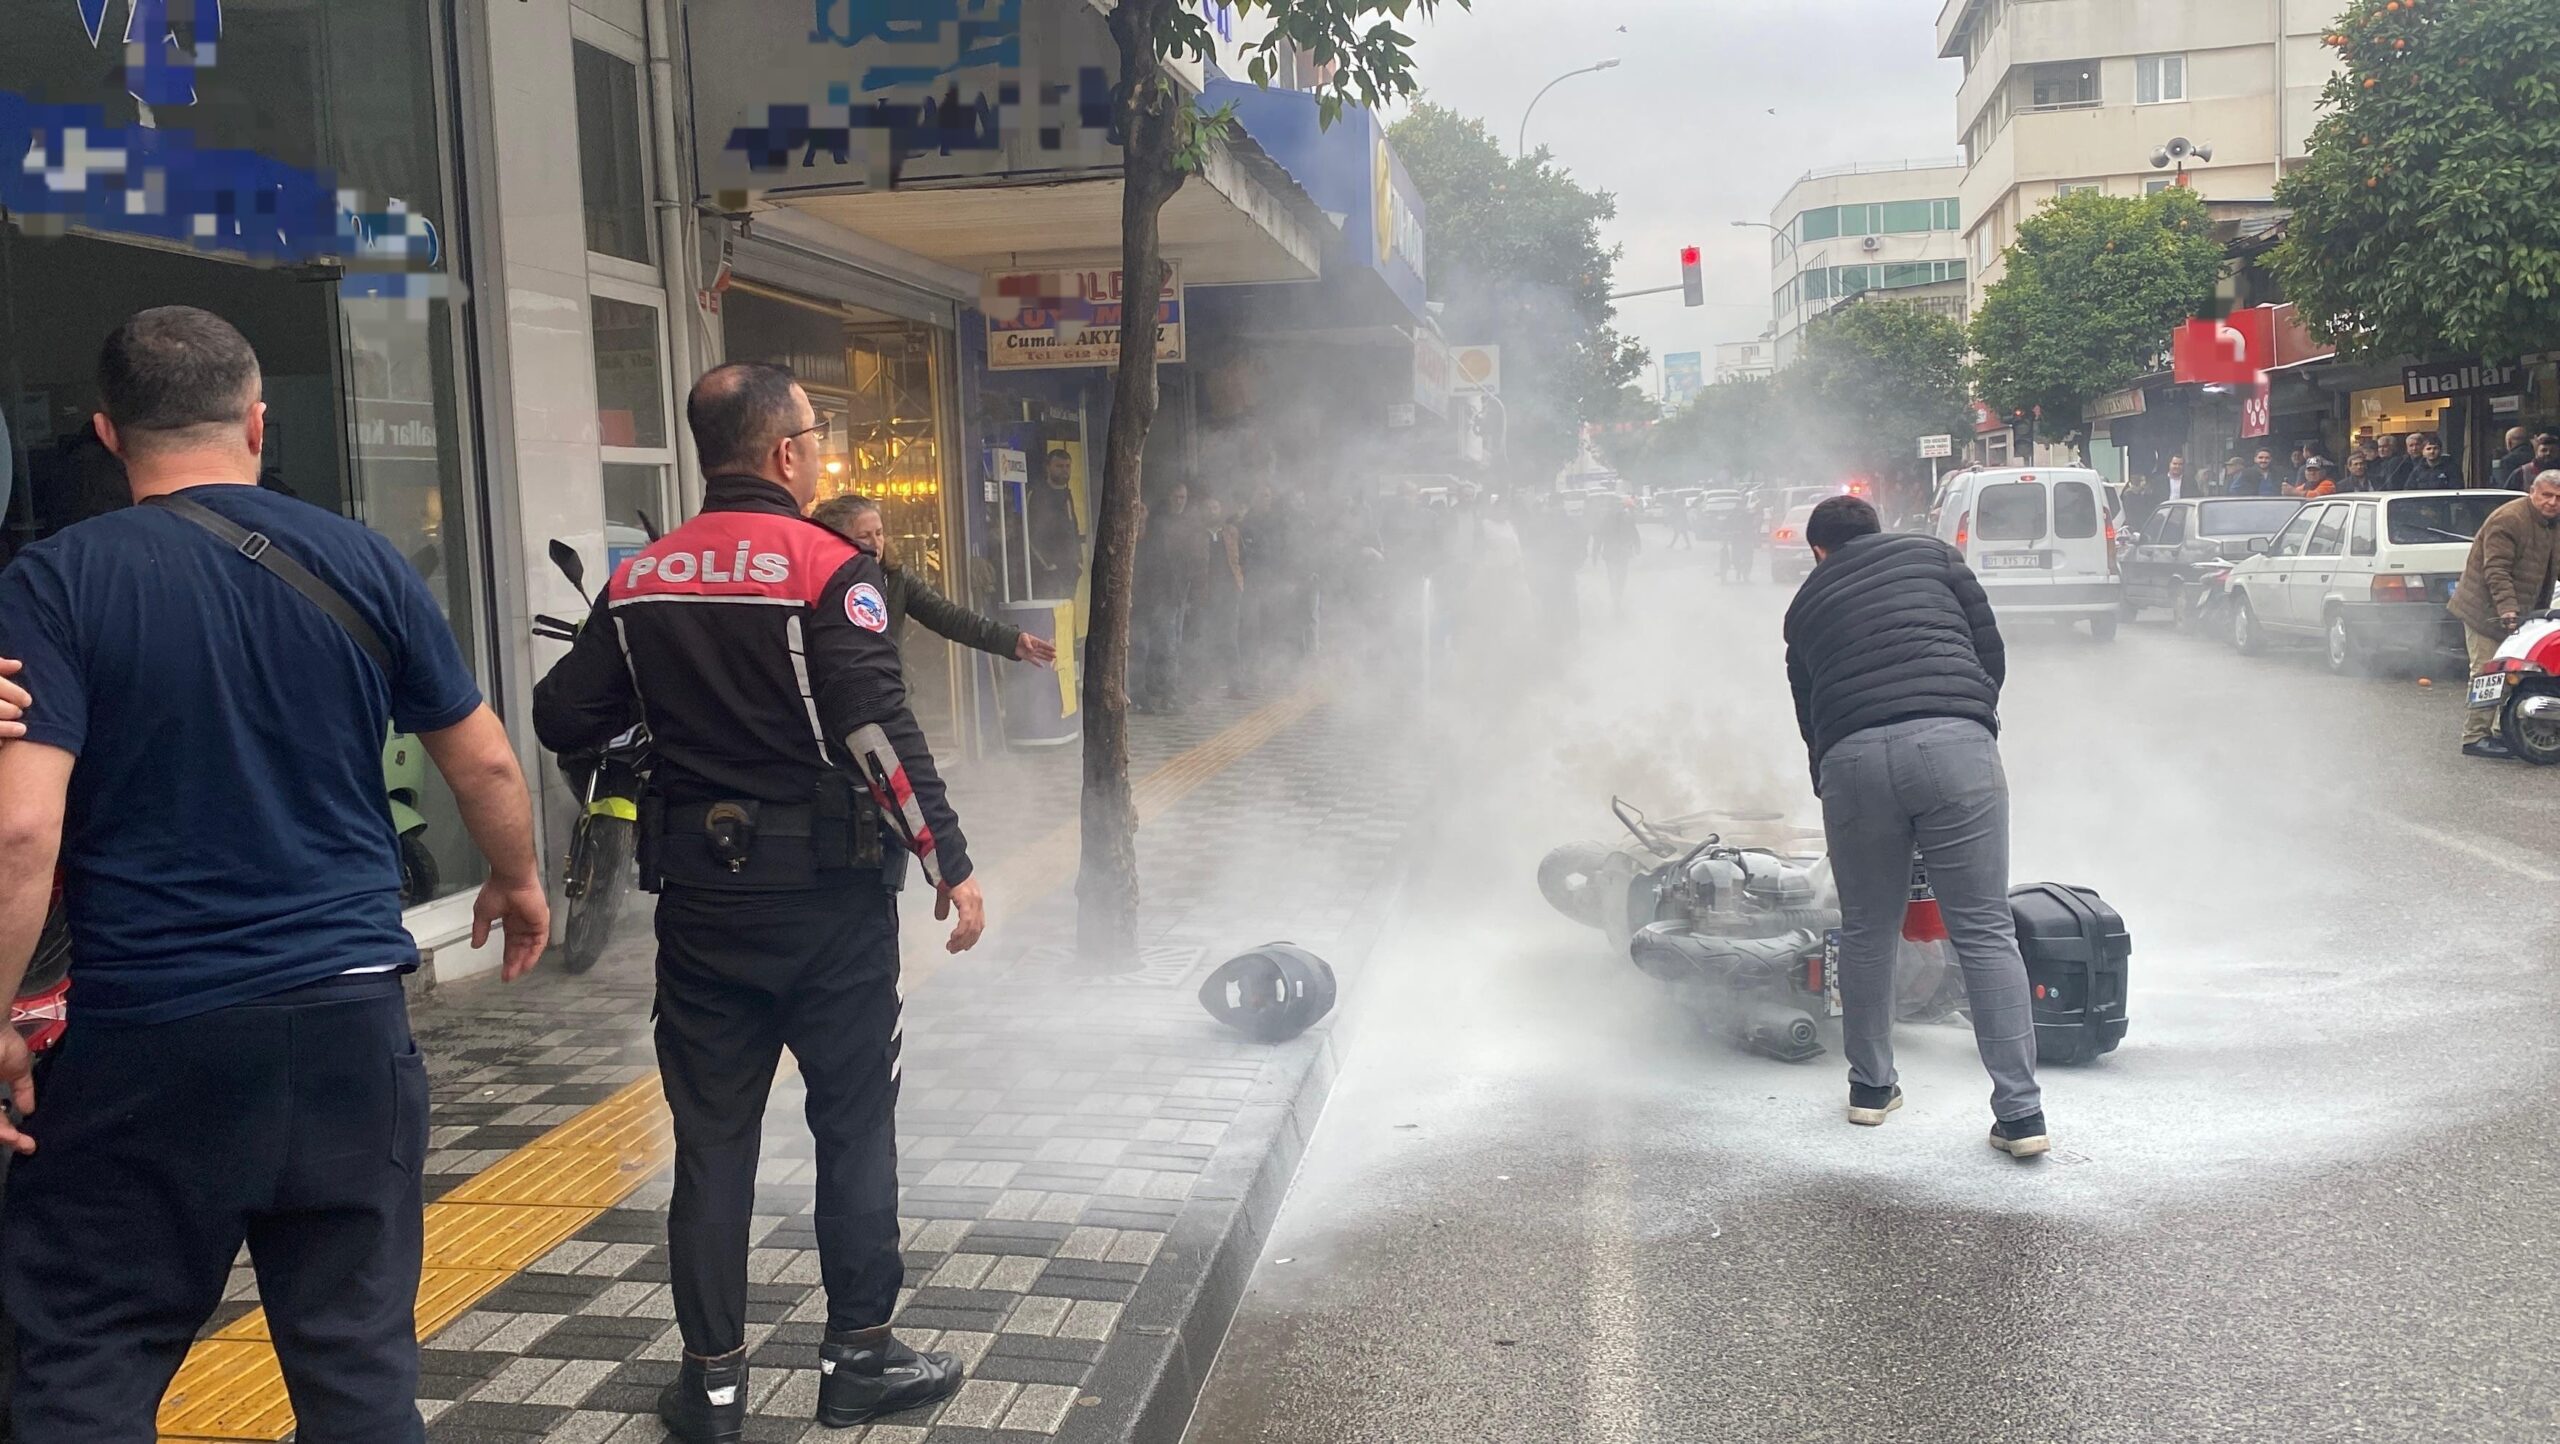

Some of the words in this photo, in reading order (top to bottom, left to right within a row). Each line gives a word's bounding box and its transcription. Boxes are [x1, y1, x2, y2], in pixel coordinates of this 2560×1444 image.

[2408, 366, 2516, 395] inallar
[627, 540, 790, 589] POLİS
[2475, 678, 2485, 689] 01
